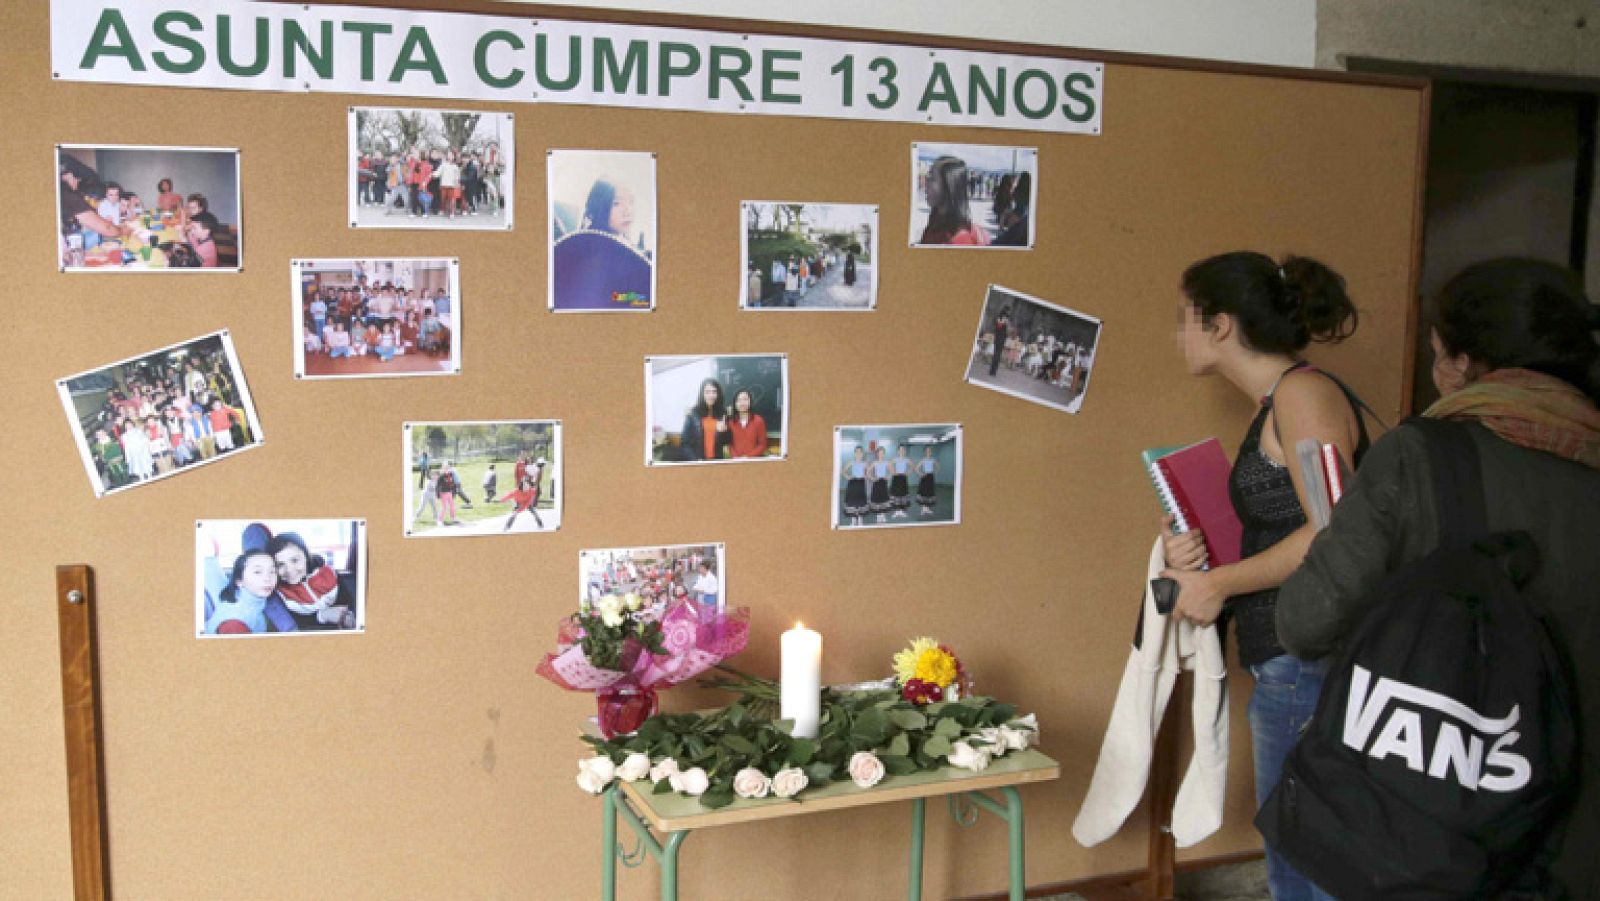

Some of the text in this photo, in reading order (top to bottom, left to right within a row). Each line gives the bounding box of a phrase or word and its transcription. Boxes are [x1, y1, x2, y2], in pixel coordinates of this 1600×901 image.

[79, 8, 1098, 123] ASUNTA CUMPRE 13 ANOS
[1342, 664, 1532, 792] VANS
